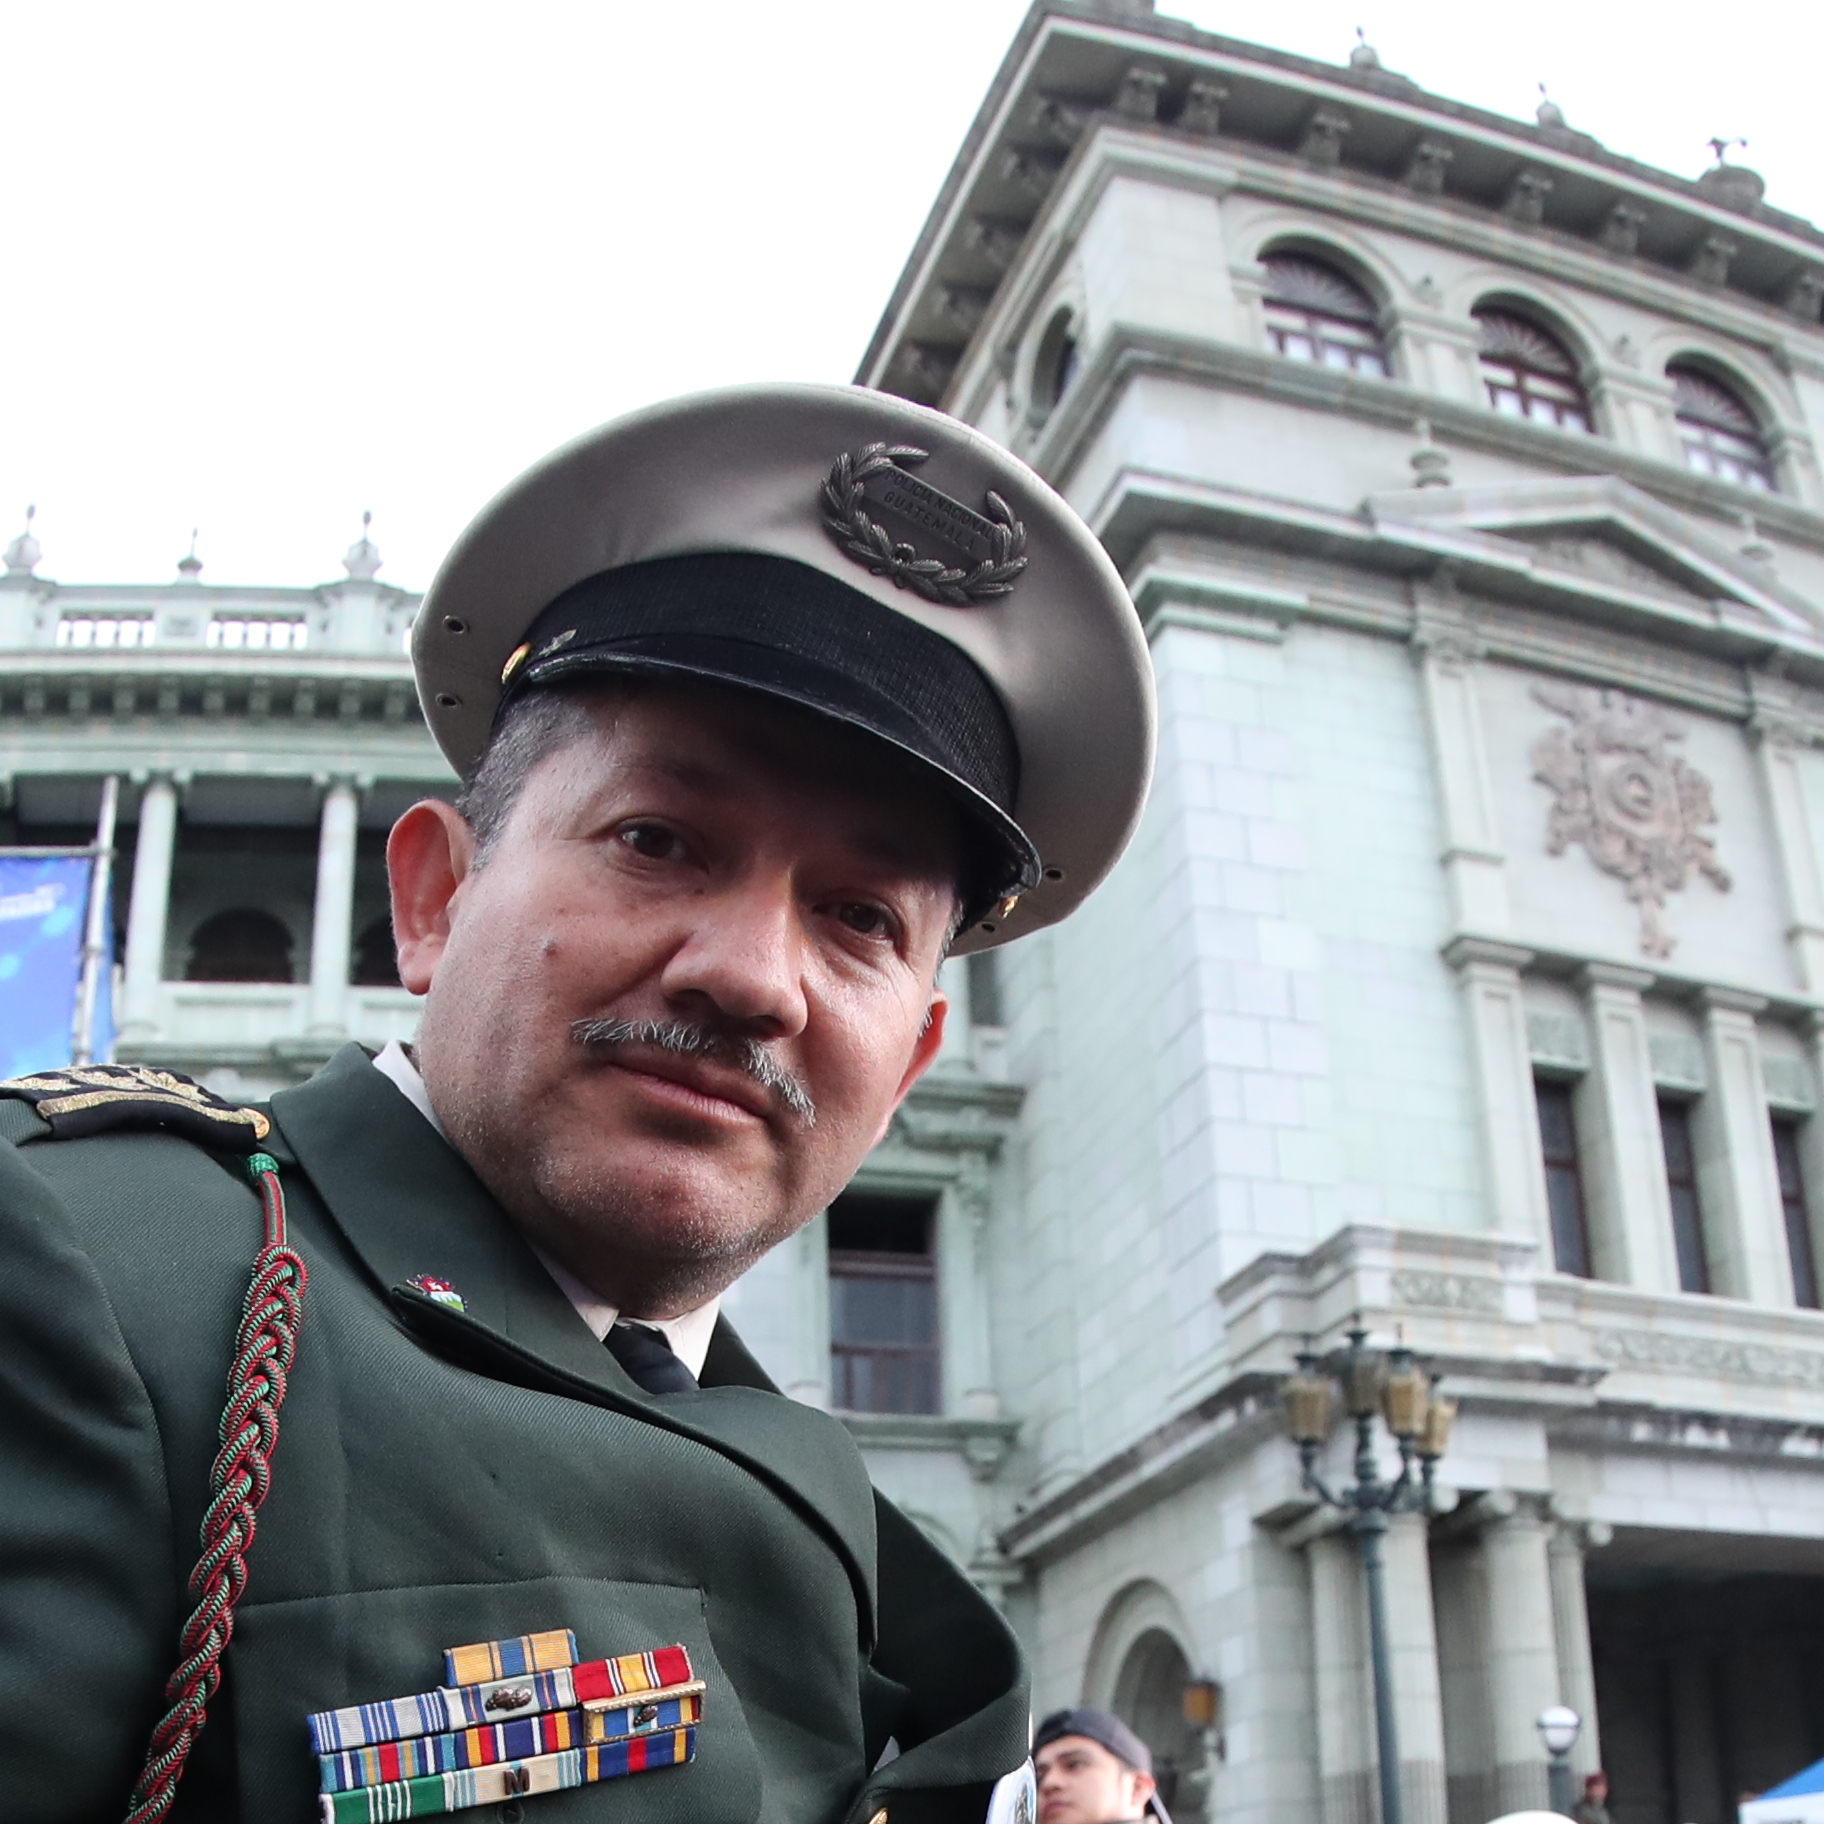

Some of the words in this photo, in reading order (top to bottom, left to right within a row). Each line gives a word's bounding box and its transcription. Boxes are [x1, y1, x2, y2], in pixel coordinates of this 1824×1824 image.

[884, 491, 974, 550] GUATEMALA
[885, 468, 934, 505] POLICIA
[935, 496, 994, 540] NACIONAL
